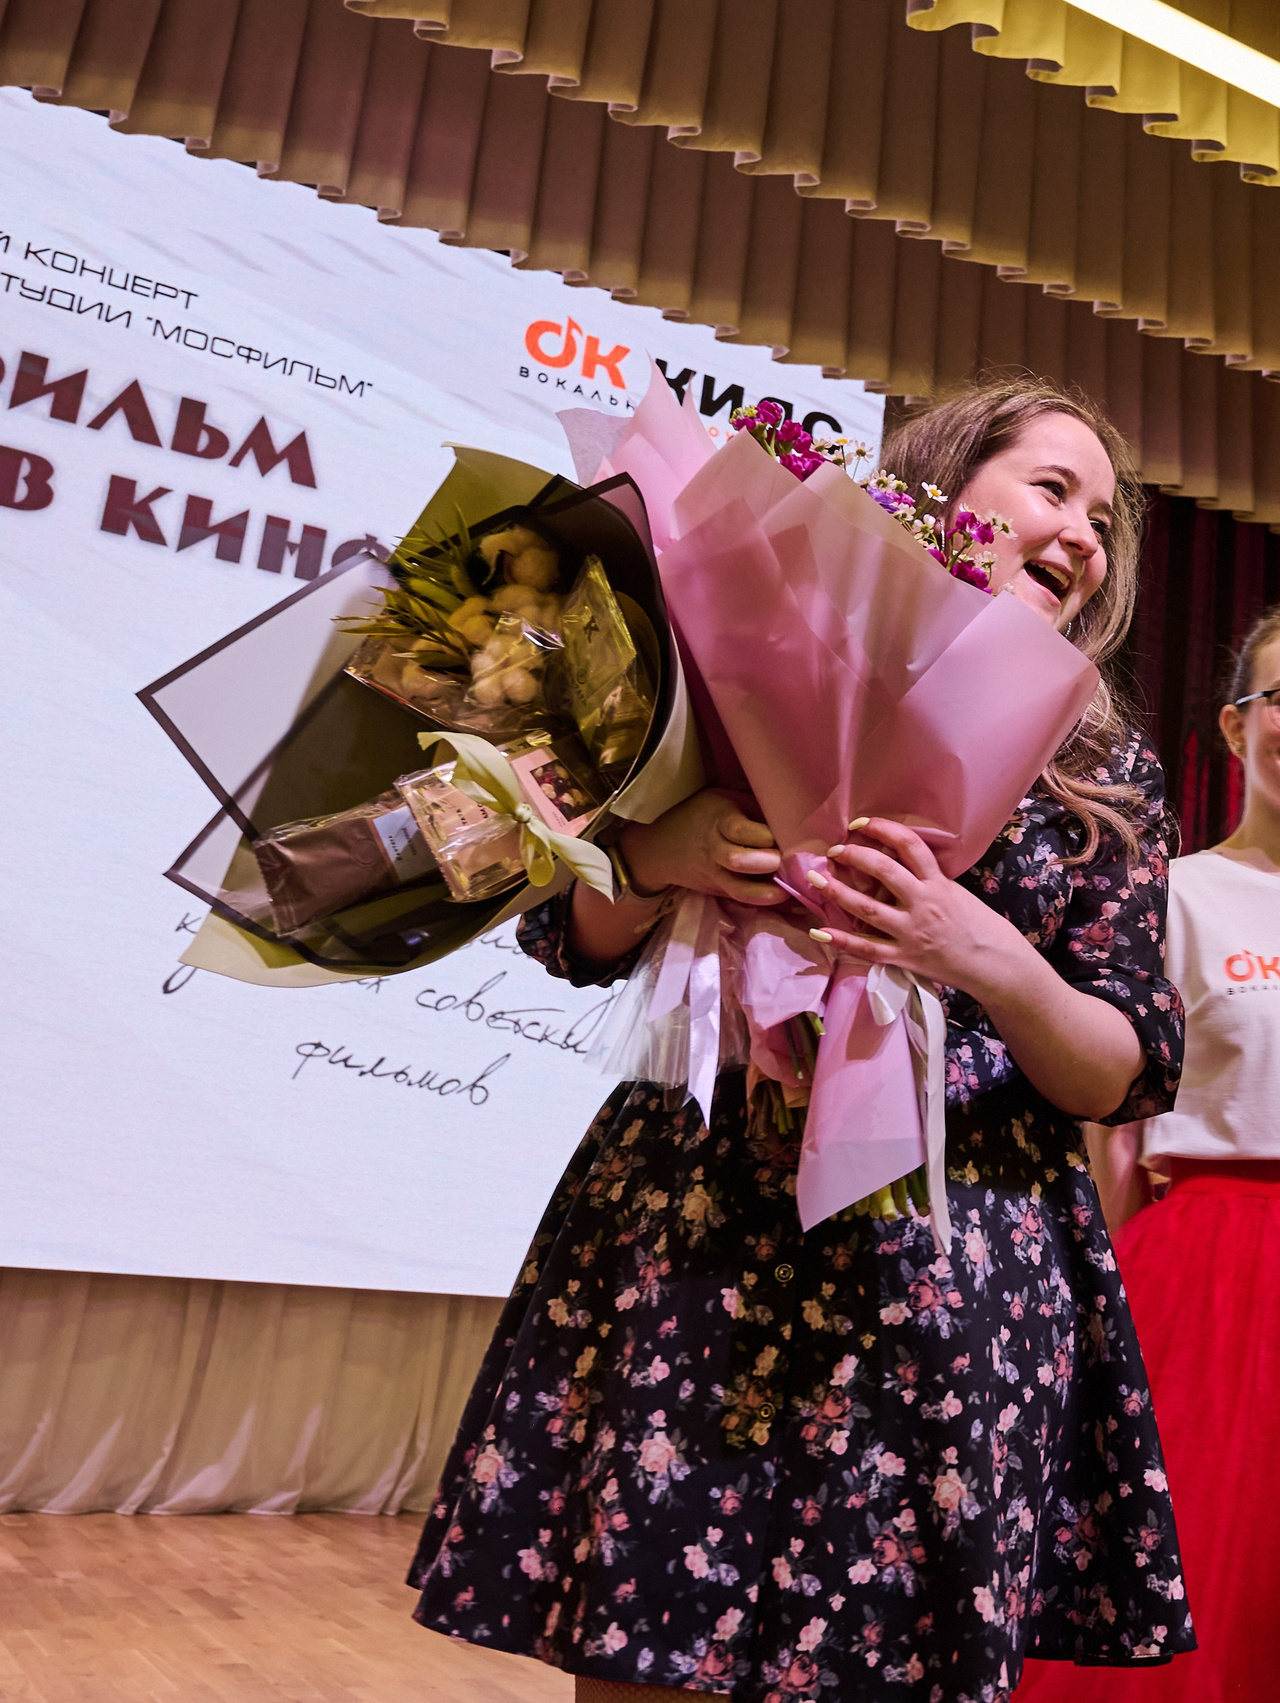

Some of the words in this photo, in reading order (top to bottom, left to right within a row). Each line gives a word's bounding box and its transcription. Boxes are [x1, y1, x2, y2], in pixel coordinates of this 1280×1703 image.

[0, 271, 133, 328] ТУДИИ
[24, 242, 198, 309] КОНЦЕРТ
[0, 350, 317, 489] ИЛЬМ
[519, 366, 635, 411] ВОКАЛЬН
[0, 445, 54, 511] В
[292, 1041, 511, 1105] фильмов
